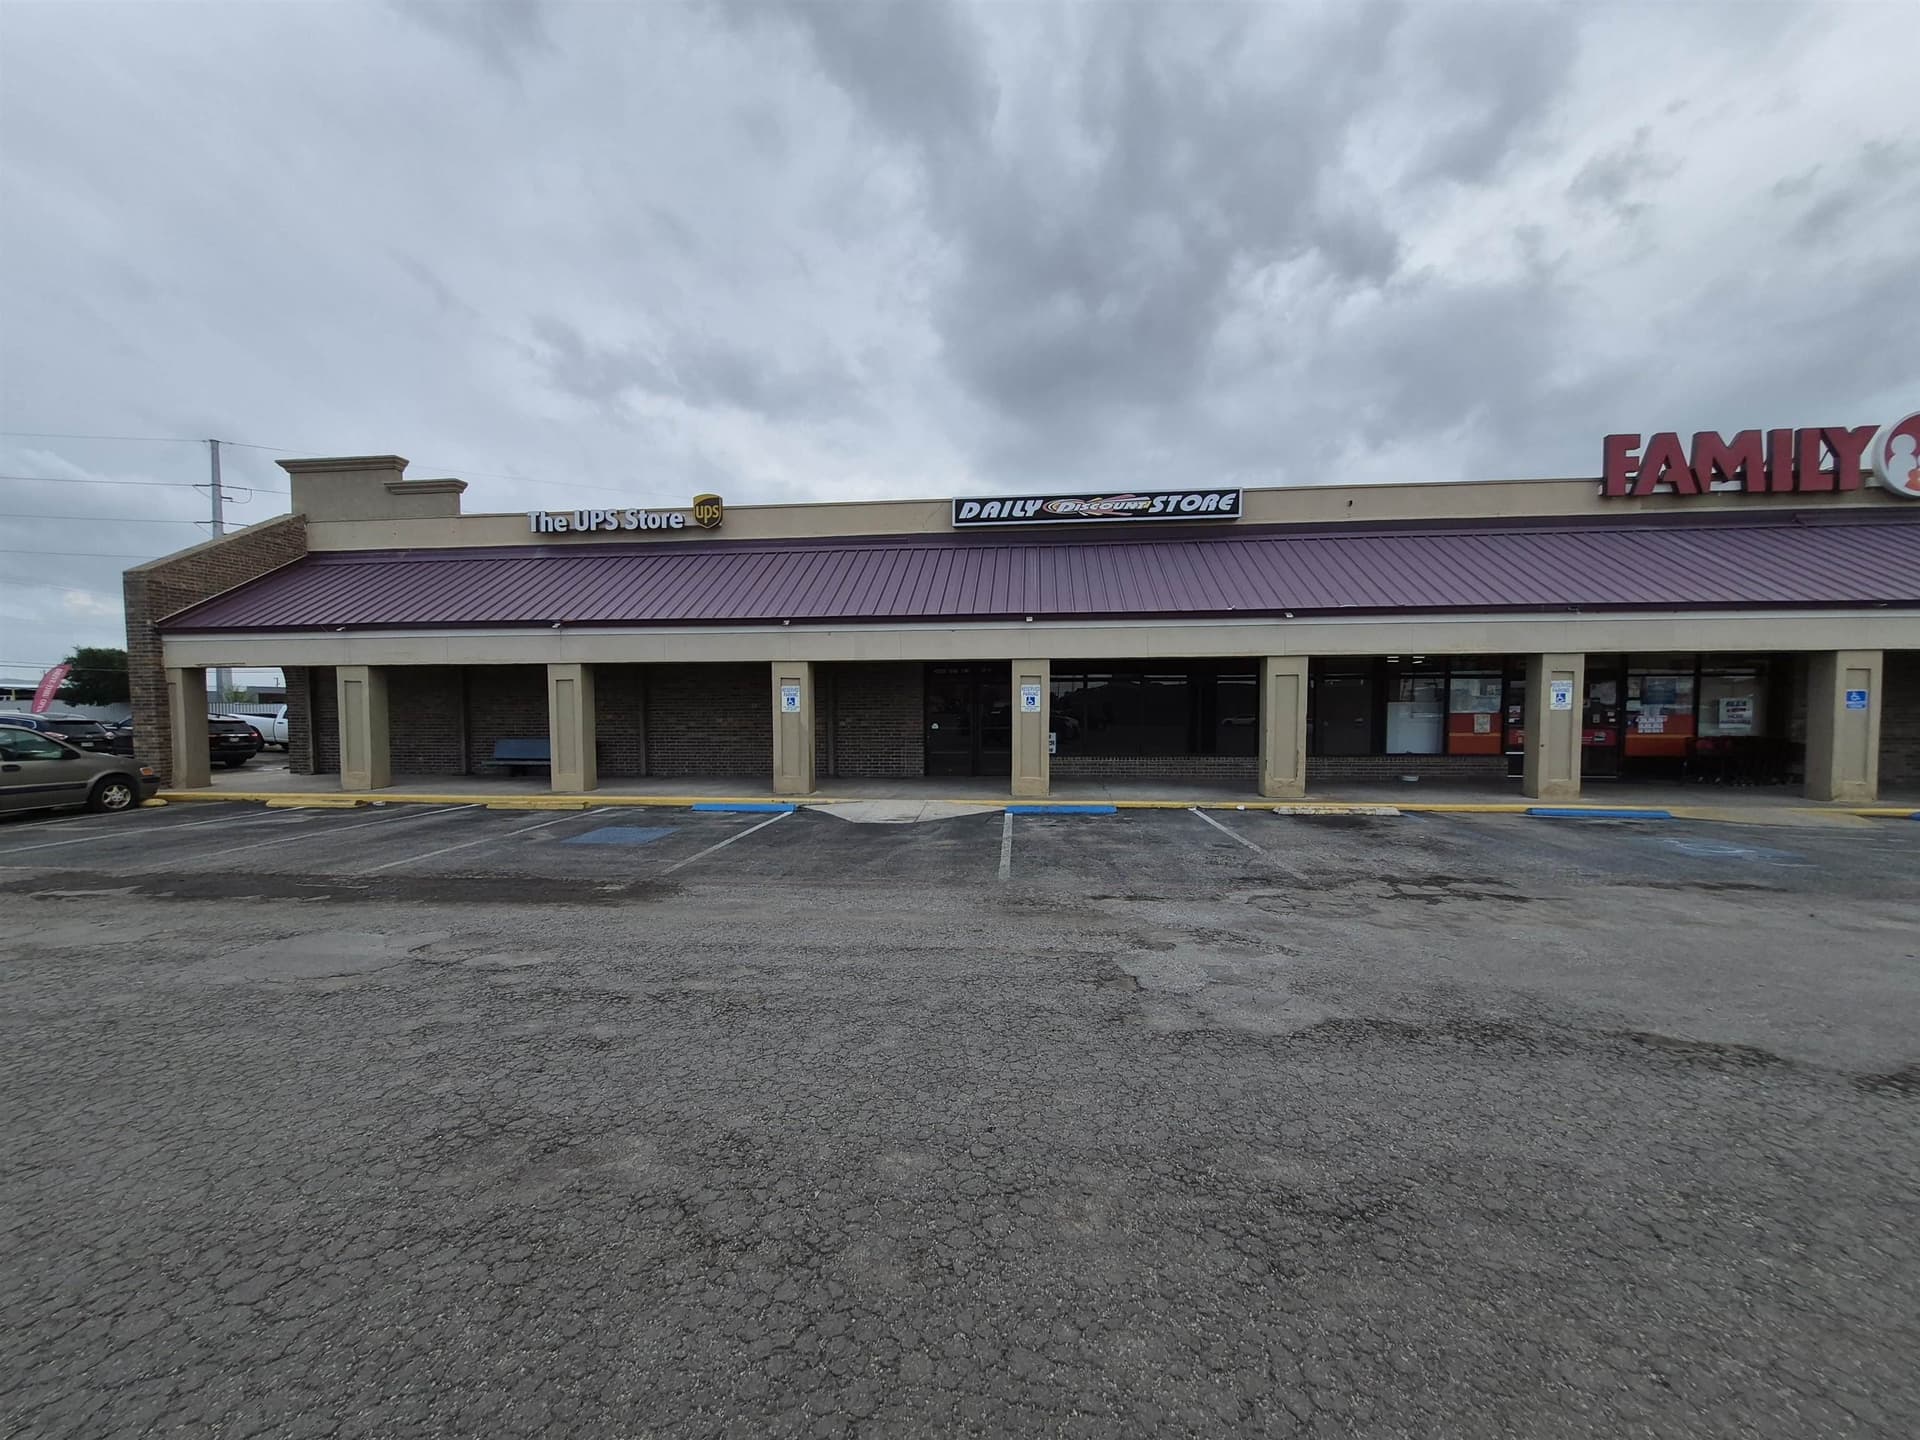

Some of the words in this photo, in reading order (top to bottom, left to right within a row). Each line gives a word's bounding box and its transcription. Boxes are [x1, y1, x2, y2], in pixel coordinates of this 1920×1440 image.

[1604, 425, 1880, 495] FAMILY
[695, 503, 720, 524] ups
[958, 499, 1043, 520] DAILY
[1147, 492, 1237, 513] STORE
[527, 510, 569, 533] The
[575, 510, 620, 532] UPS
[624, 508, 685, 531] Store
